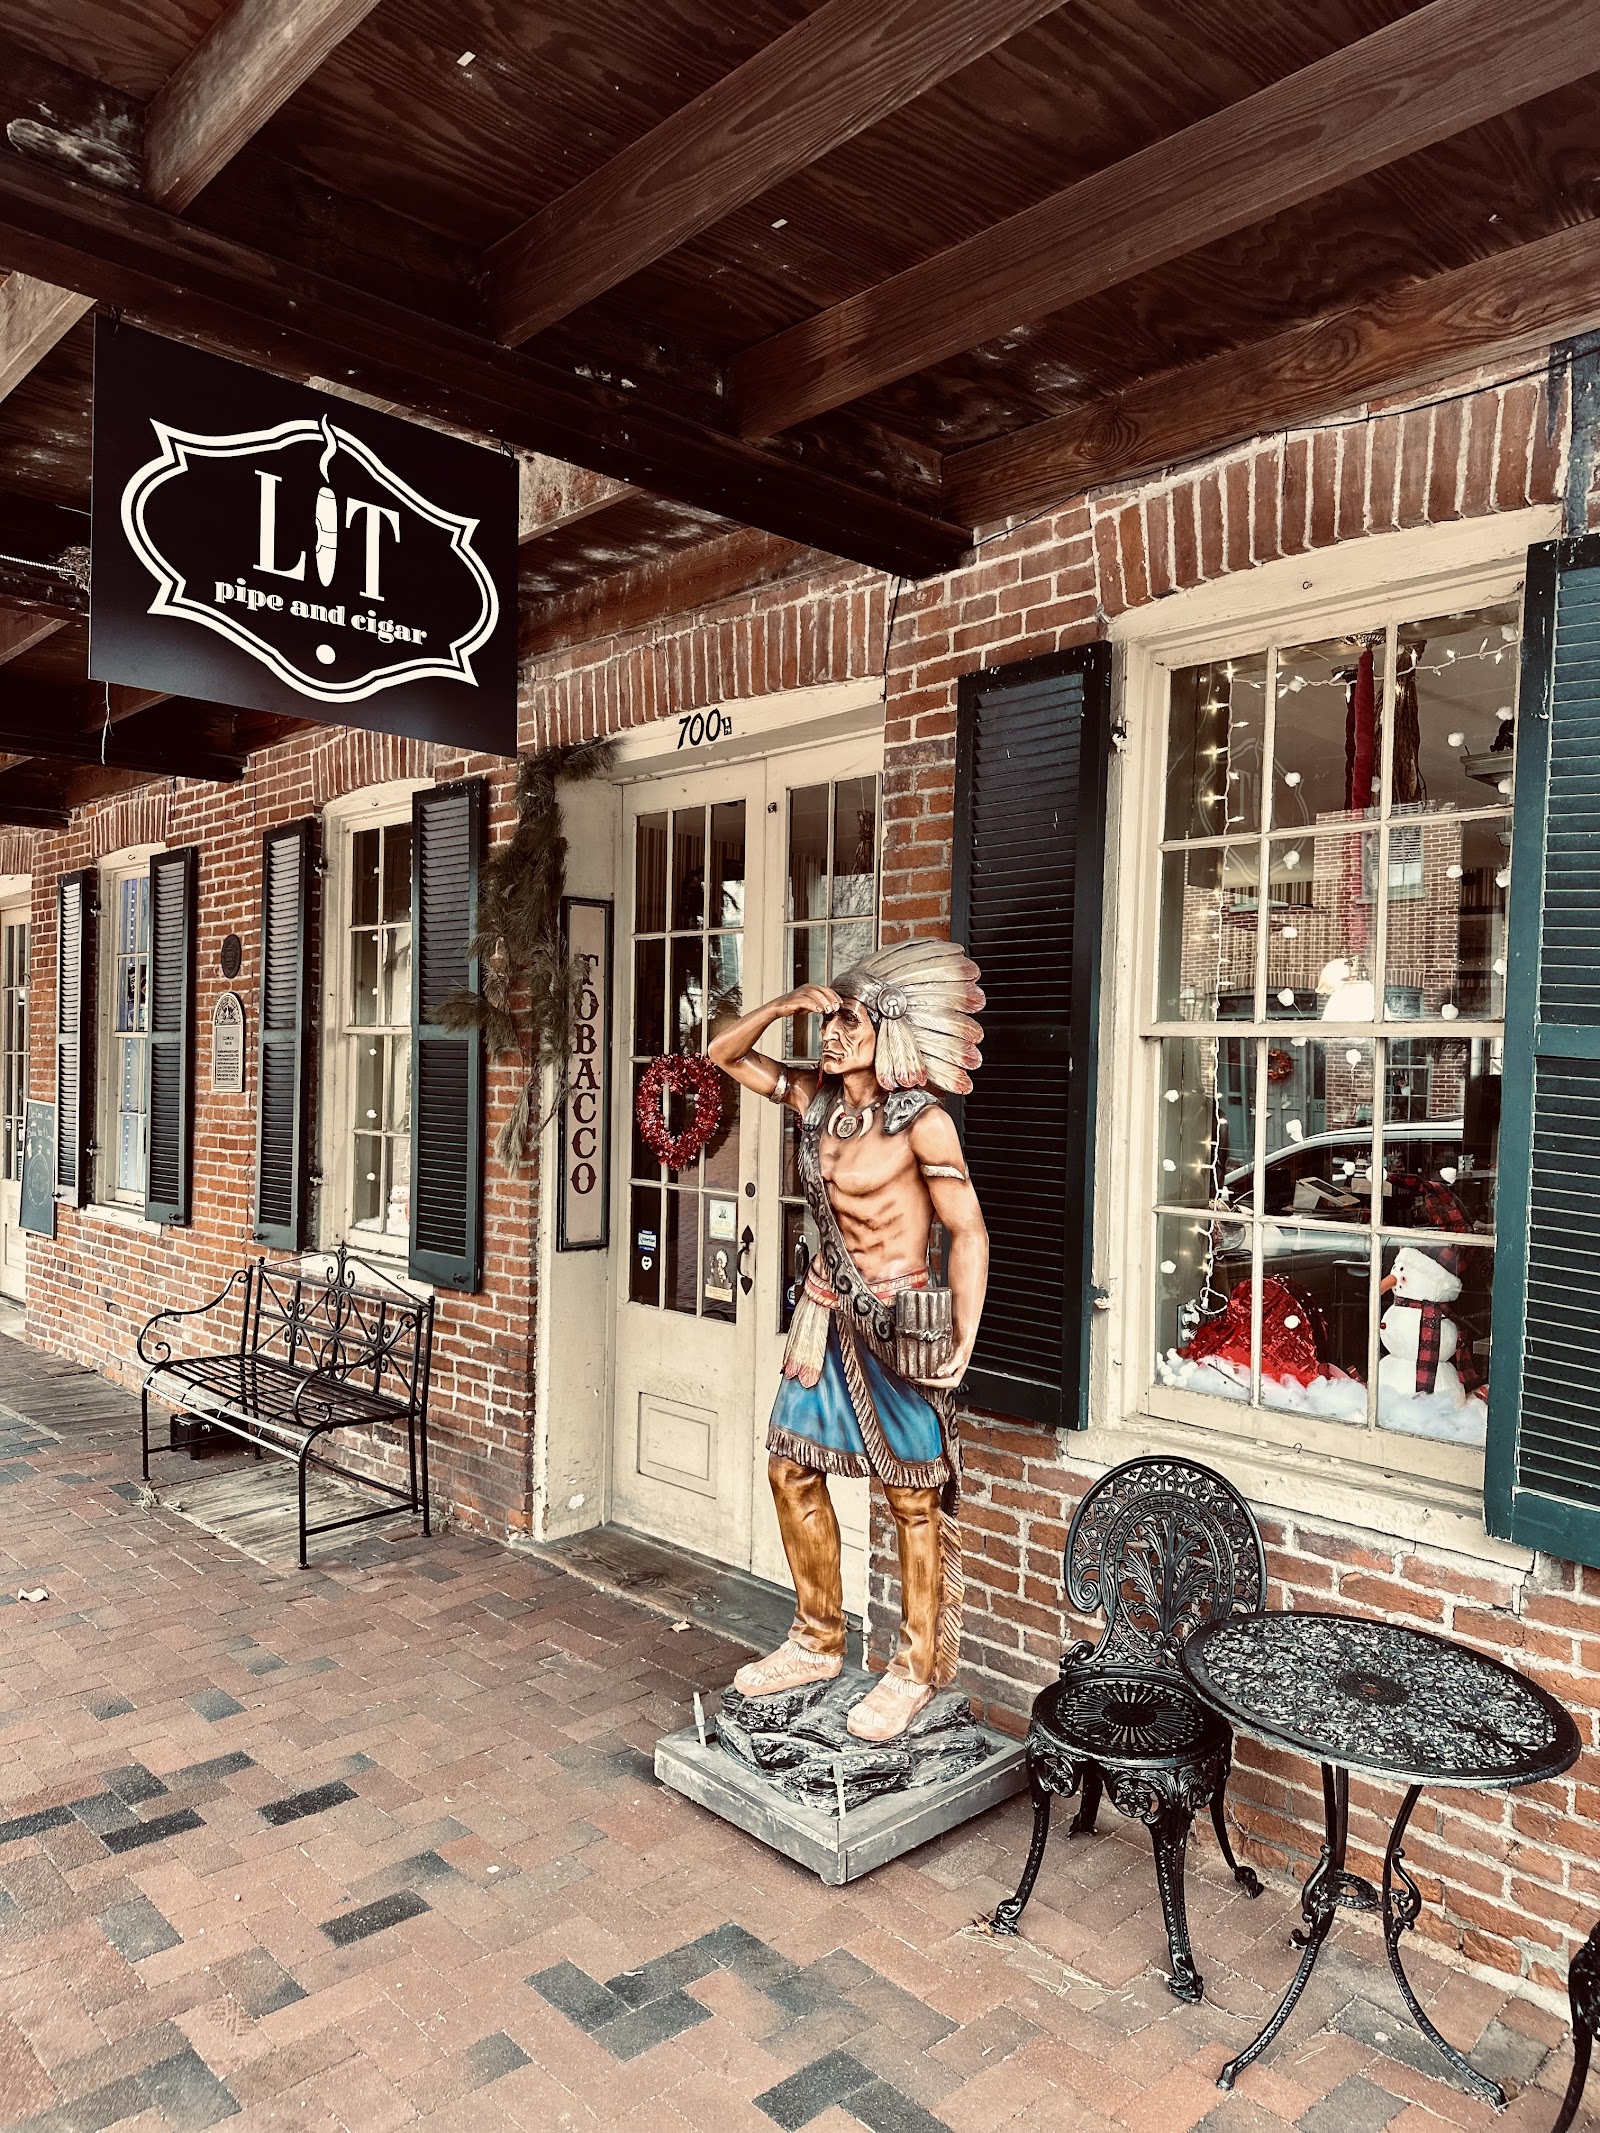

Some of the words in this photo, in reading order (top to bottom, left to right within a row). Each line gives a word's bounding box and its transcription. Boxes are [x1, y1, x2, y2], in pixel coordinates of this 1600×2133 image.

[253, 469, 401, 602] LIT
[214, 577, 284, 613] pipe
[290, 596, 346, 626] and
[351, 611, 428, 645] cigar
[571, 953, 601, 1195] TOBACCO
